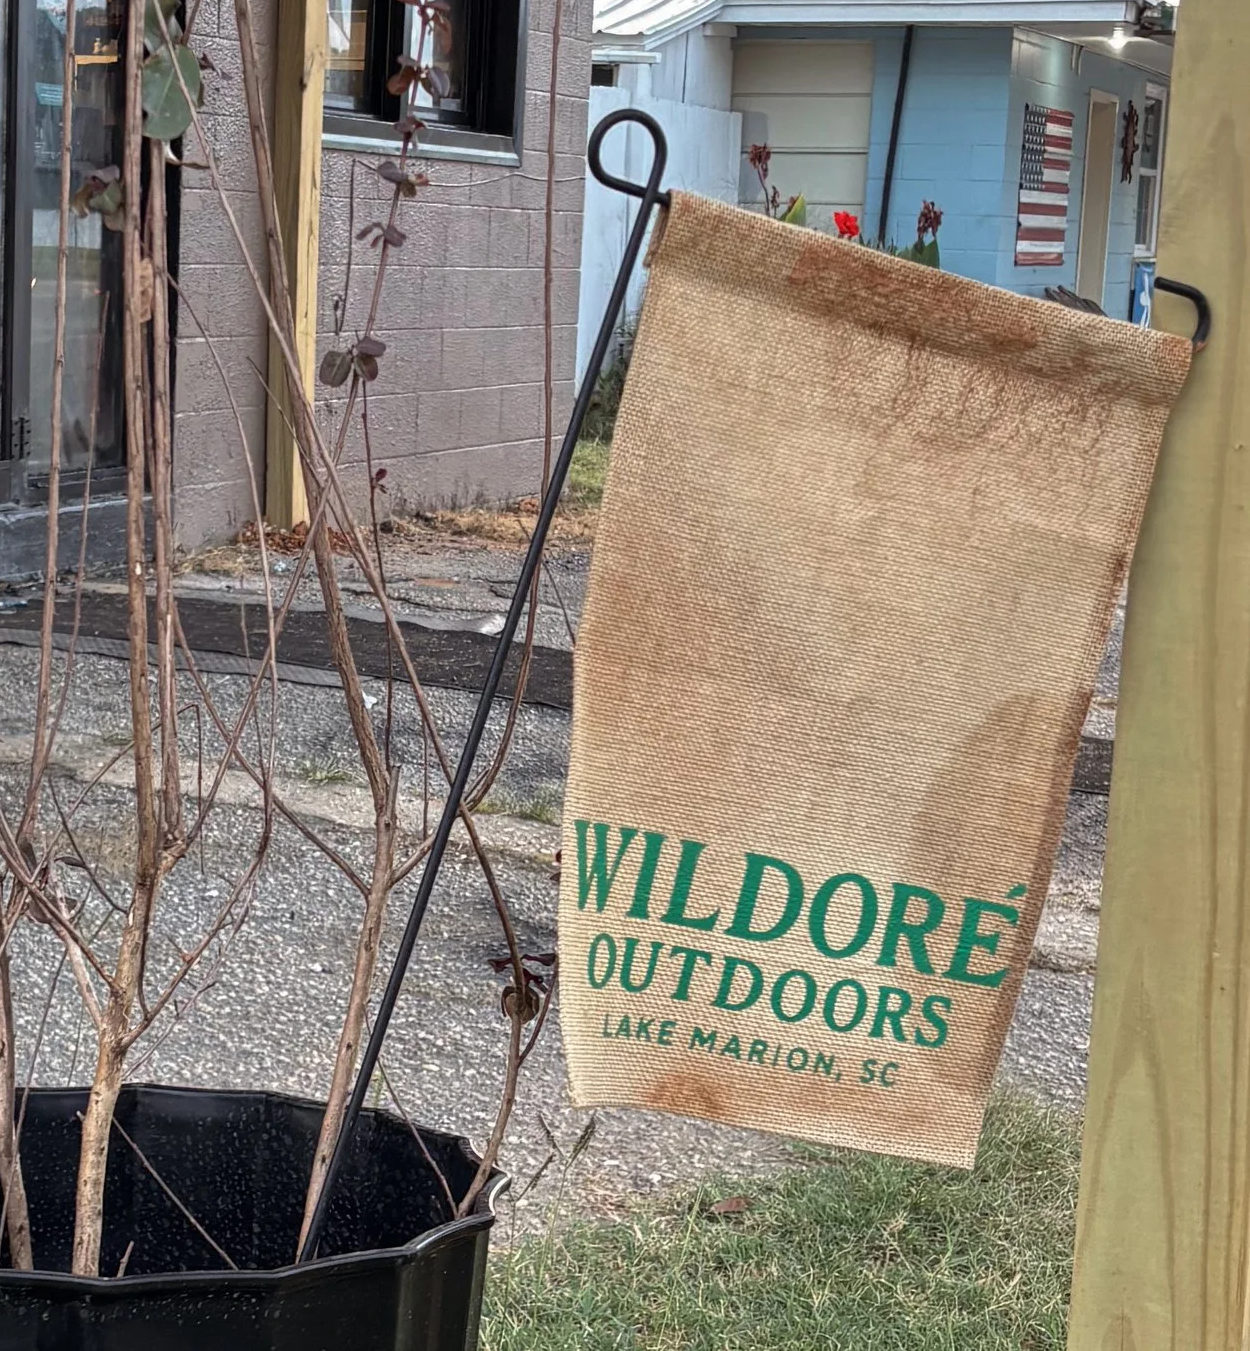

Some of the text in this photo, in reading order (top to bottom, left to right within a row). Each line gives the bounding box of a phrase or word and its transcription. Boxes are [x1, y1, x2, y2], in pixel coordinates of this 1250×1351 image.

[573, 819, 1028, 989] WILDORÉ
[587, 932, 952, 1049] OUTDOORS
[602, 1013, 901, 1088] LAKE MARION, SC
